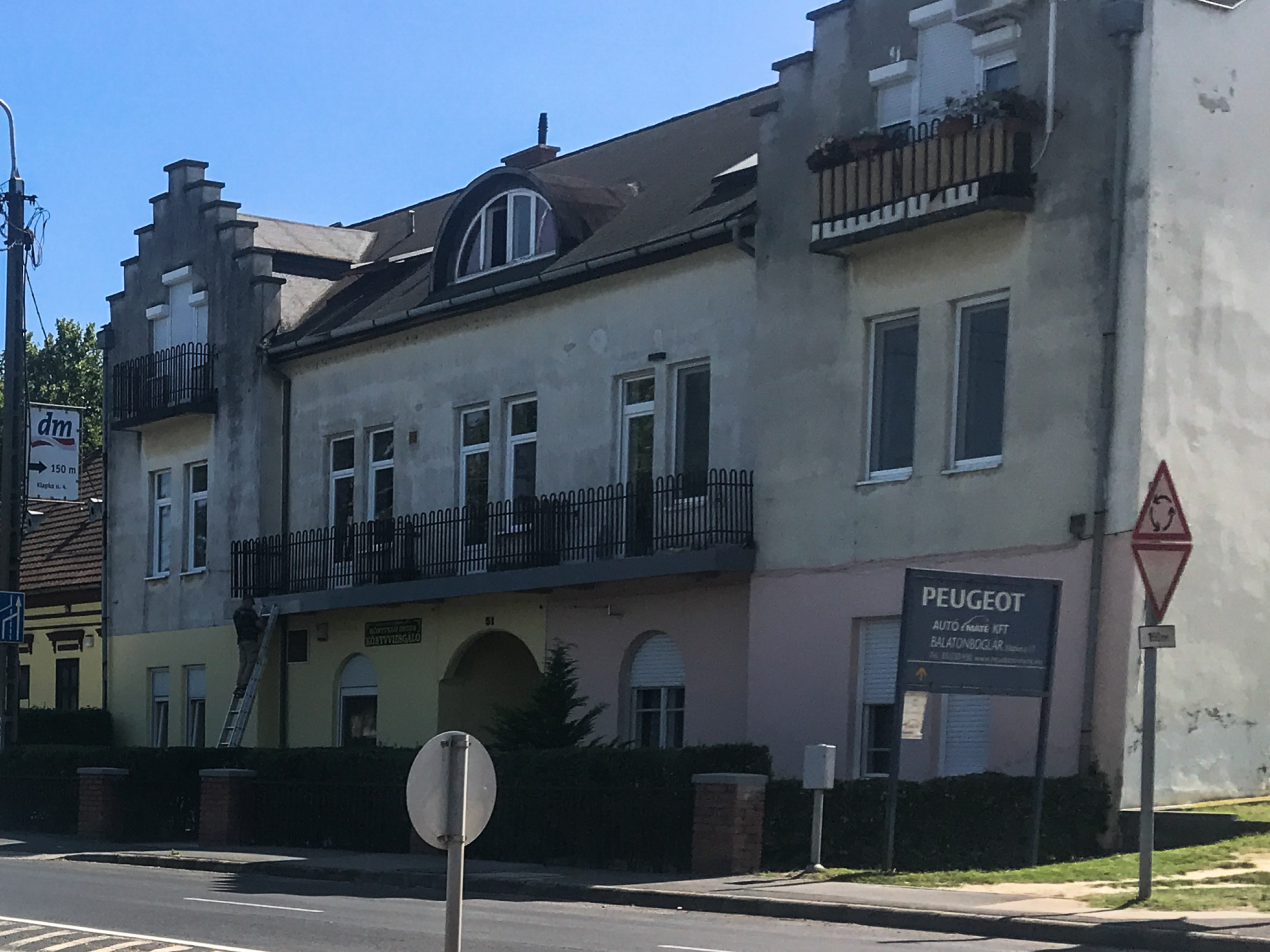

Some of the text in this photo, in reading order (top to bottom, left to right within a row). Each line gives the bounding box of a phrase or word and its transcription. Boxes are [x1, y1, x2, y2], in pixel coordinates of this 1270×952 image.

[37, 411, 73, 438] dm
[50, 464, 77, 475] 150 m
[922, 586, 1025, 612] PEUGEOT
[992, 624, 1010, 634] KFT
